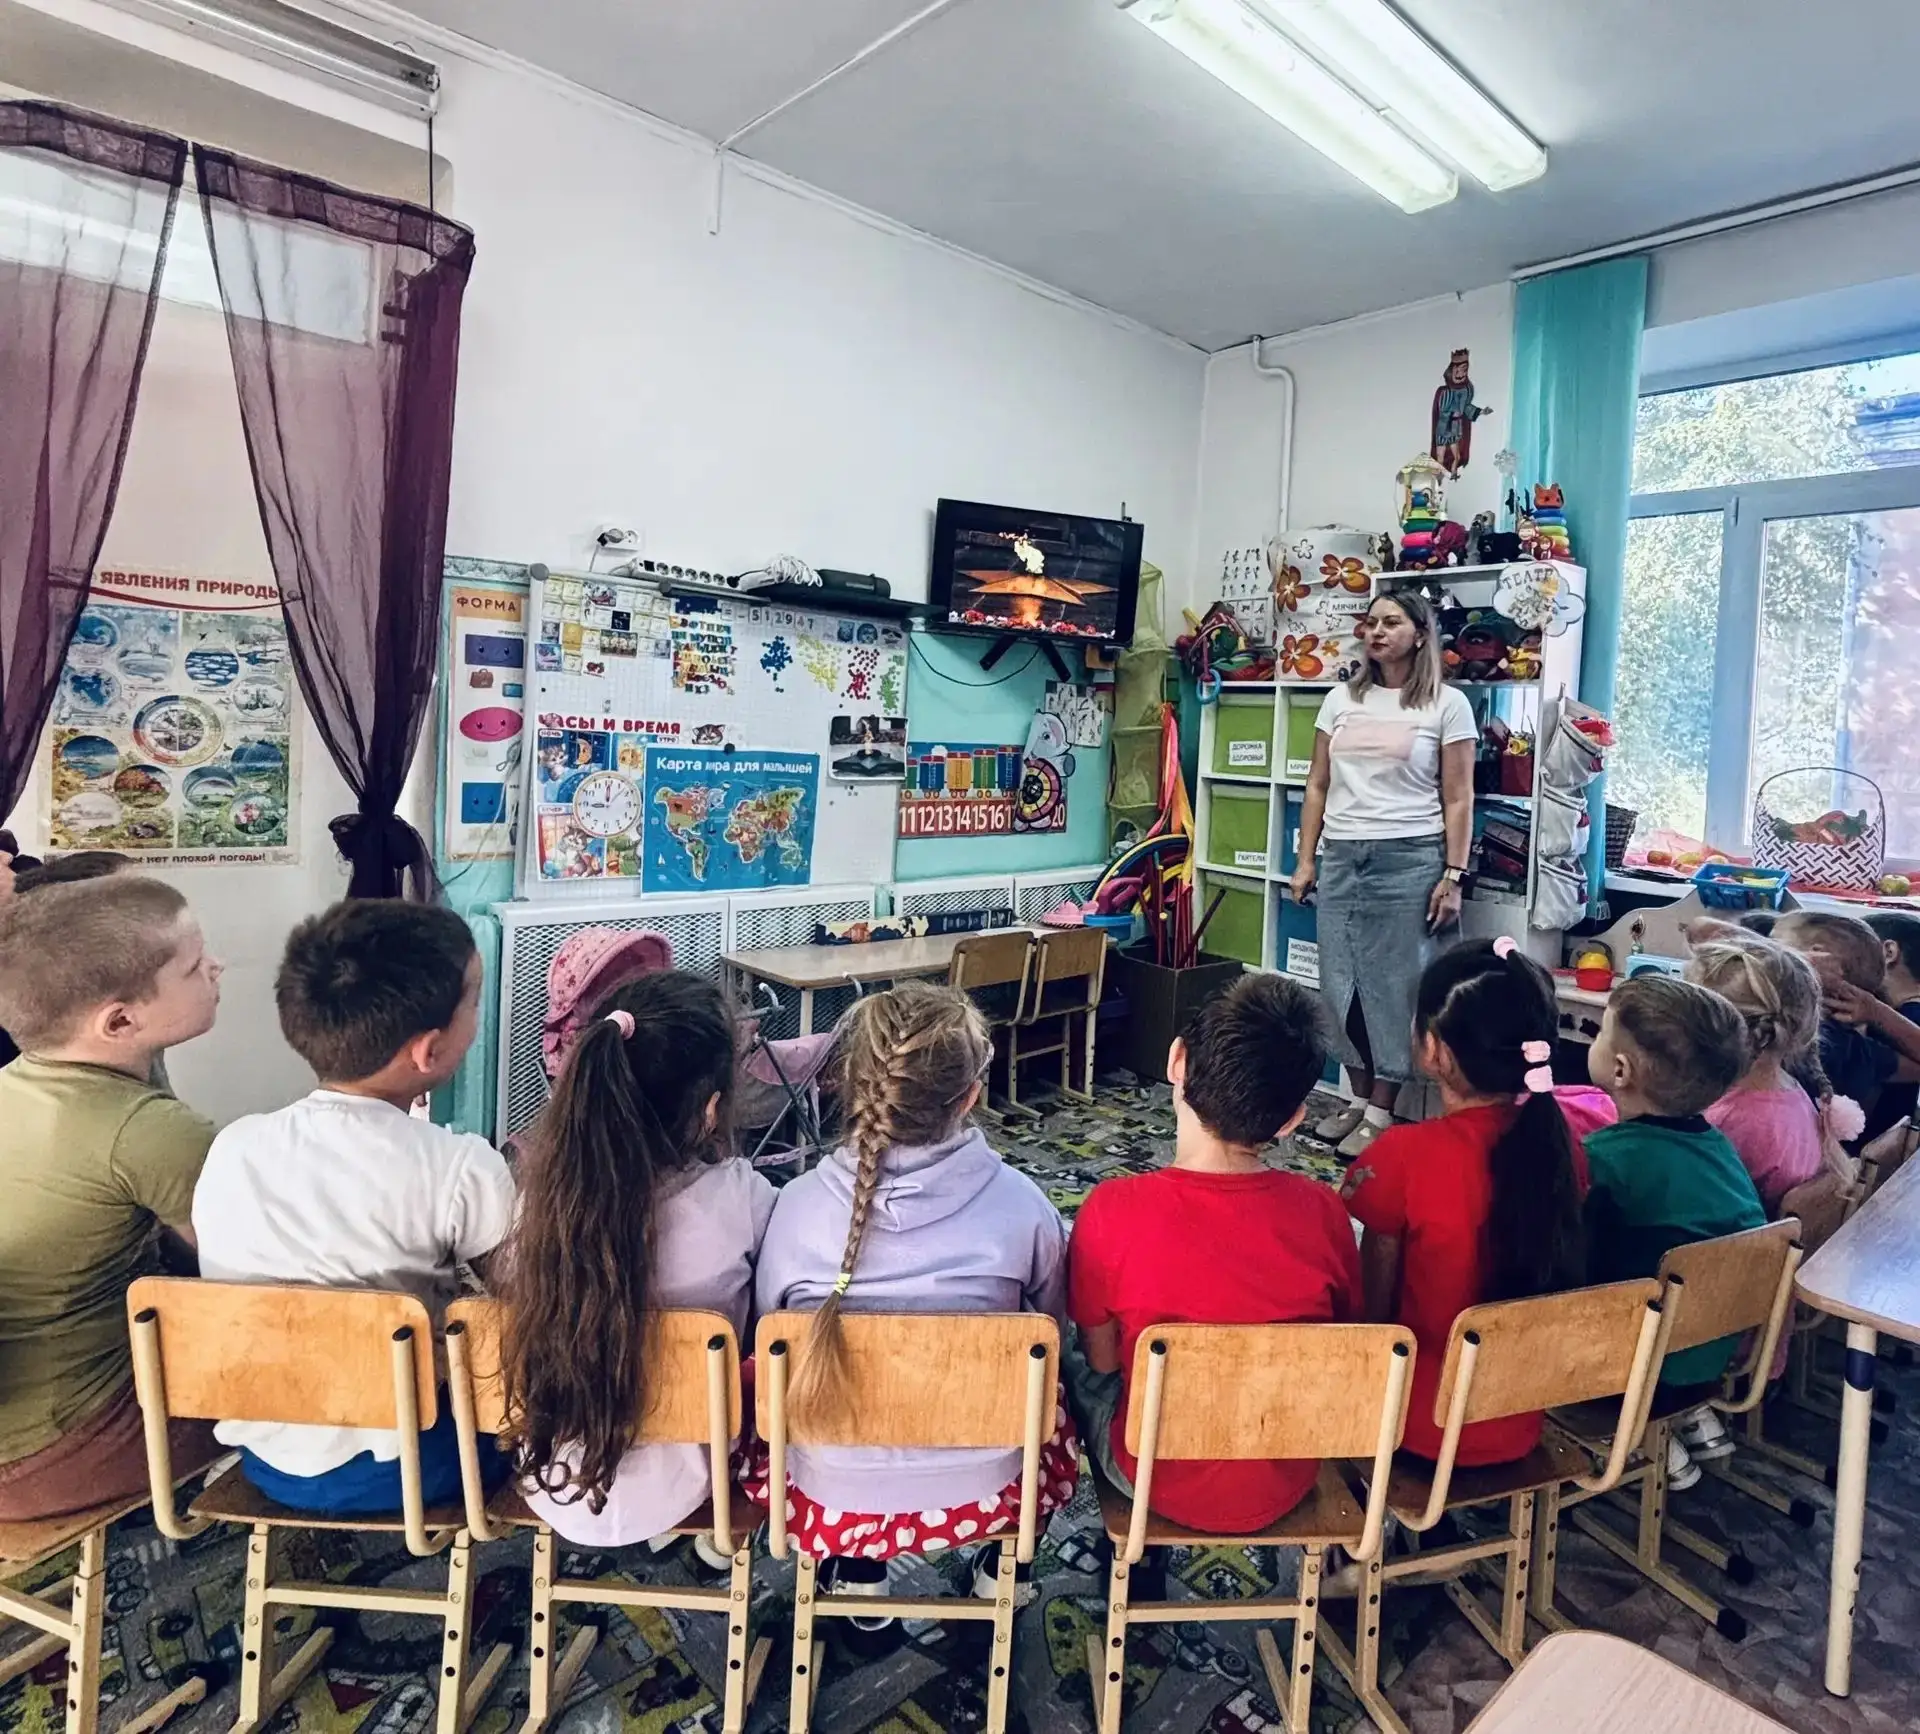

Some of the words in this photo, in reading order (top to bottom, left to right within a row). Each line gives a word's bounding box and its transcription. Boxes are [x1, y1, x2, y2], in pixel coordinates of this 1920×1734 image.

[100, 571, 190, 591] ЯВЛЕНИЯ
[1503, 568, 1553, 590] ТЕАТР
[456, 596, 516, 612] ФОРМА
[603, 718, 615, 731] И
[623, 719, 681, 735] ВРЕМЯ
[656, 757, 702, 773] Карта
[733, 764, 760, 773] для
[900, 807, 915, 833] 11
[918, 807, 934, 832] 12
[936, 806, 952, 831] 13
[955, 805, 971, 830] 14
[973, 805, 987, 830] 15
[989, 804, 1004, 829] 16
[172, 853, 215, 863] плохой
[219, 852, 266, 863] погоды!
